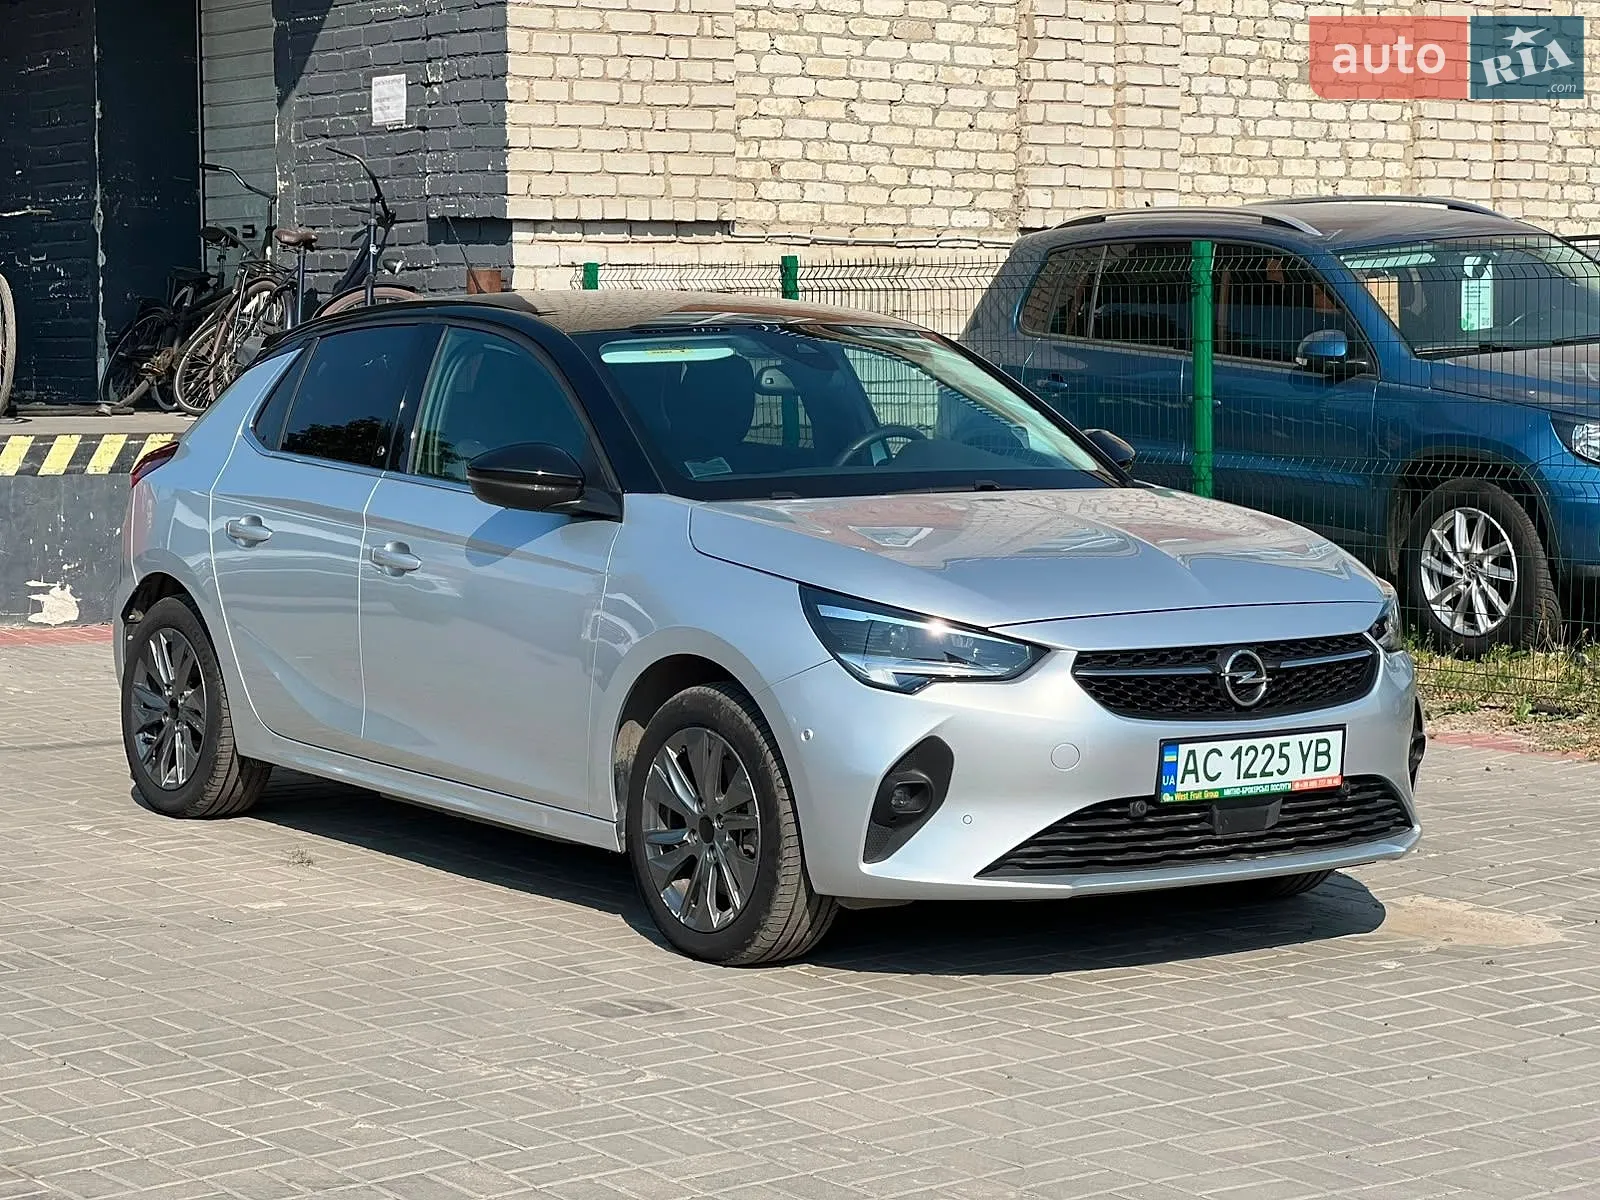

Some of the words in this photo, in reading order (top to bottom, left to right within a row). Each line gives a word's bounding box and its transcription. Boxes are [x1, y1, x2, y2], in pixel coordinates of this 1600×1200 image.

[1180, 748, 1223, 785] AC
[1230, 743, 1290, 780] 1225
[1298, 738, 1332, 775] YB
[1162, 775, 1176, 786] UA
